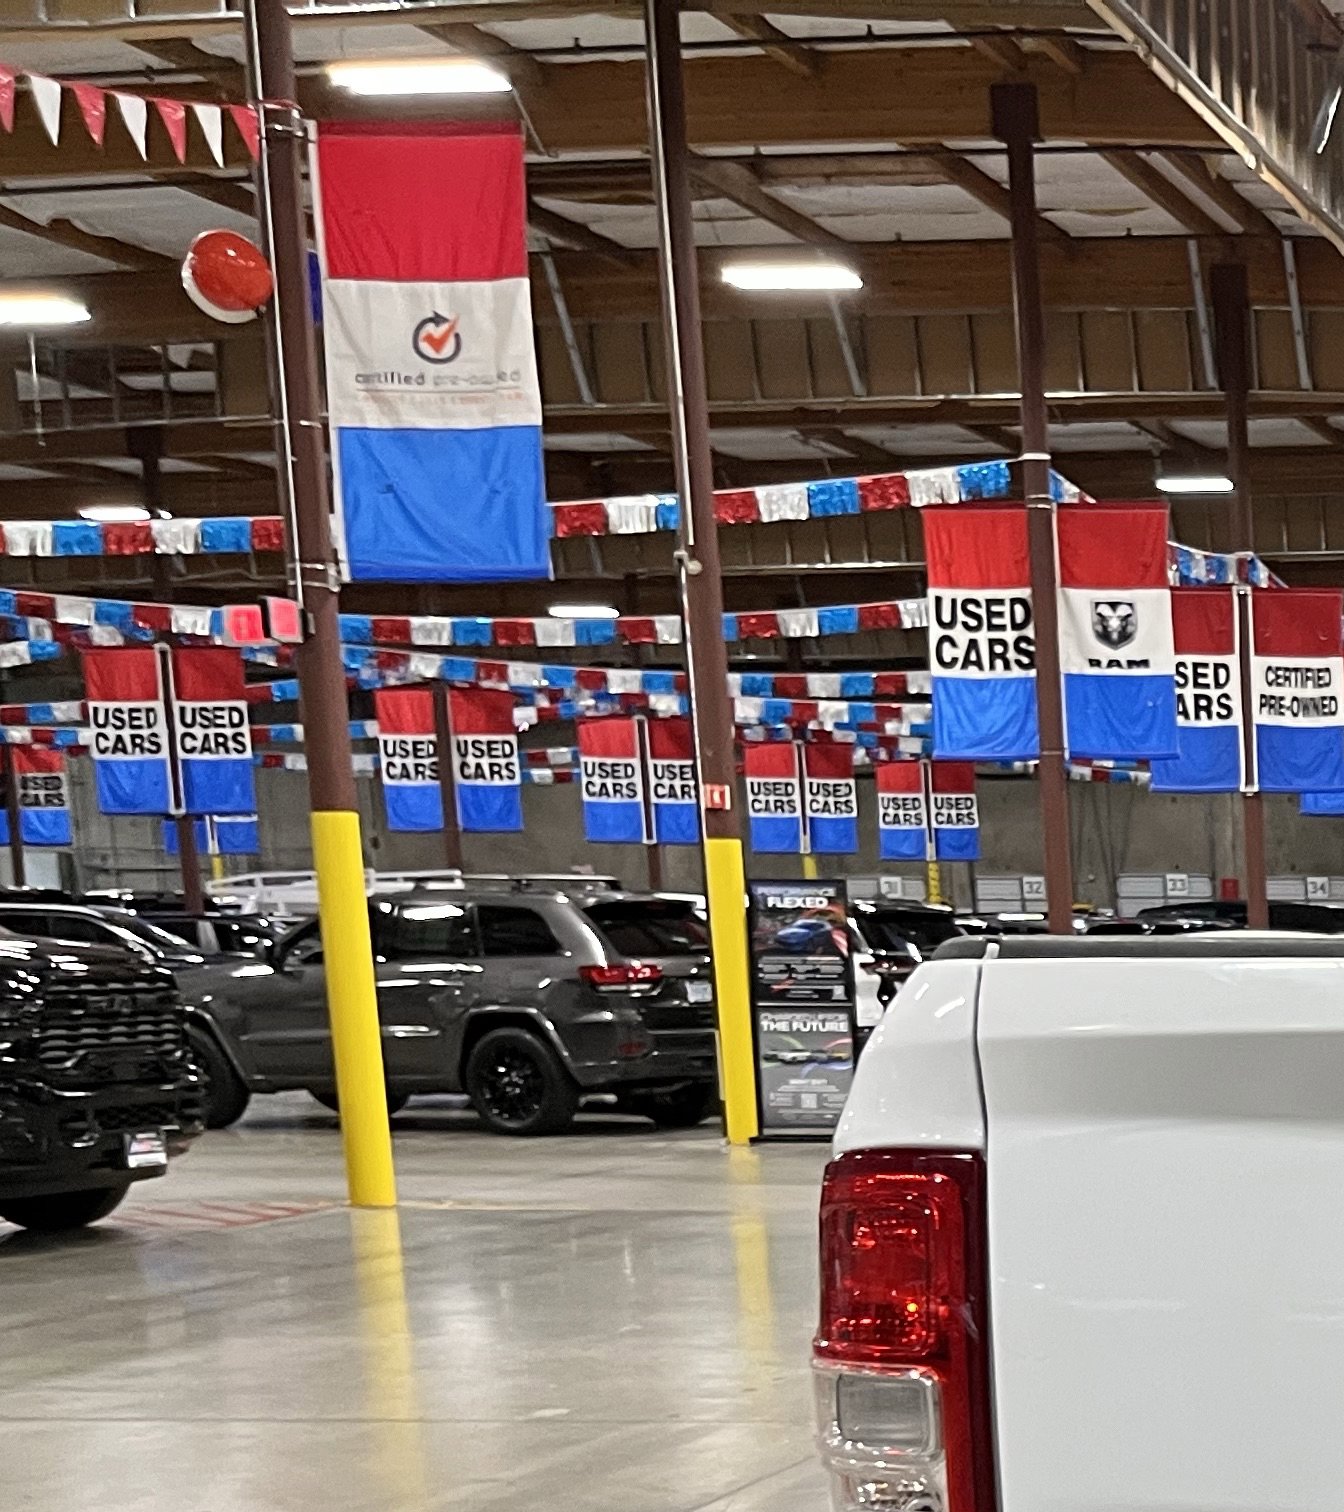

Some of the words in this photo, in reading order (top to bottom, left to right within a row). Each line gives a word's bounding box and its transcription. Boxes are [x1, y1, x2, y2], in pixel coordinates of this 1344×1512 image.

[934, 596, 1032, 632] USED
[935, 635, 1036, 672] CARS
[1088, 658, 1150, 669] RAM
[1175, 661, 1230, 689] SED
[1265, 665, 1332, 688] CERTIFIED
[1176, 693, 1233, 720] ARS
[1259, 693, 1338, 717] PRE-OWNED
[92, 705, 157, 730] USED
[179, 704, 245, 730] USED
[94, 731, 162, 756] CARS
[180, 731, 247, 755] CARS
[383, 740, 437, 759] USED
[456, 740, 514, 759] USED
[386, 761, 440, 780] CARS
[460, 761, 516, 780] CARS
[584, 762, 635, 779] USED
[653, 763, 693, 780] USE
[585, 781, 638, 799] CARS
[654, 783, 697, 799] CAR
[750, 781, 796, 797] USED
[808, 781, 852, 798] USED
[751, 798, 797, 814] CARS
[809, 798, 854, 814] CARS
[881, 796, 922, 810] USED
[934, 796, 974, 810] USED
[882, 811, 923, 826] CARS
[935, 811, 976, 826] CARS
[761, 1020, 790, 1032] THE
[793, 1020, 848, 1032] FUTURE
